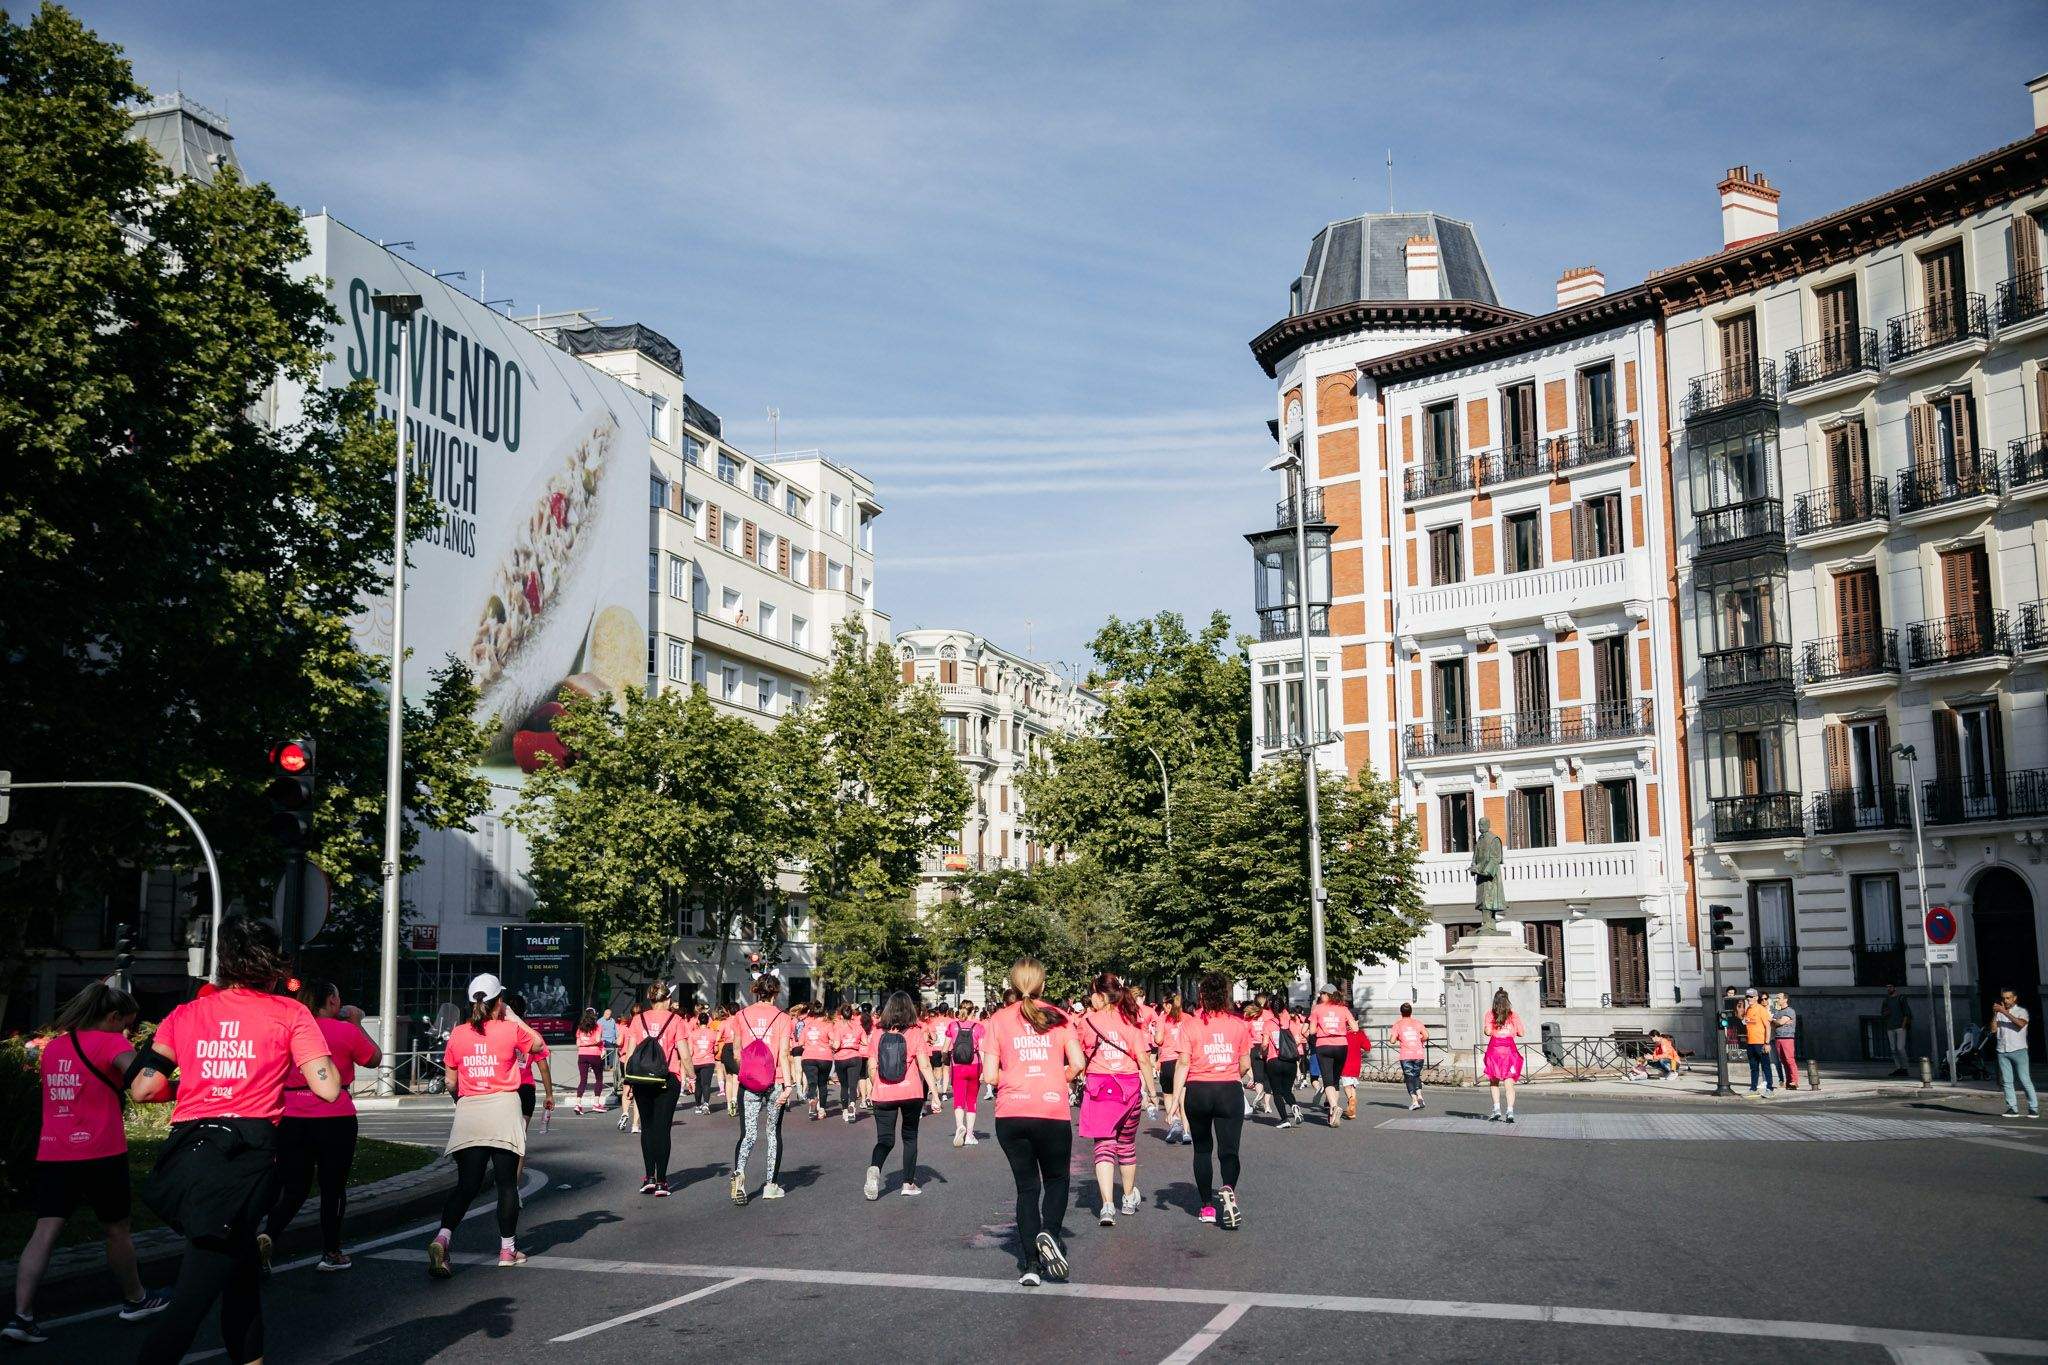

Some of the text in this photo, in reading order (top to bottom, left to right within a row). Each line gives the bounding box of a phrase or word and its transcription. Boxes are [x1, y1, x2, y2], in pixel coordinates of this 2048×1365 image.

[347, 278, 521, 453] SIRVIENDO
[443, 509, 476, 558] AÑOS
[526, 937, 561, 945] TALENT
[219, 1020, 240, 1039] TU
[1013, 1035, 1053, 1050] DORSAL
[1211, 1033, 1225, 1043] TU
[196, 1039, 256, 1059] DORSAL
[473, 1043, 487, 1055] TU
[1019, 1048, 1048, 1062] SUMA
[1203, 1043, 1234, 1054] DORSAL
[58, 1059, 72, 1073] TU
[462, 1054, 500, 1067] DORSAL
[201, 1060, 248, 1079] SUMA
[468, 1066, 495, 1078] SUMA
